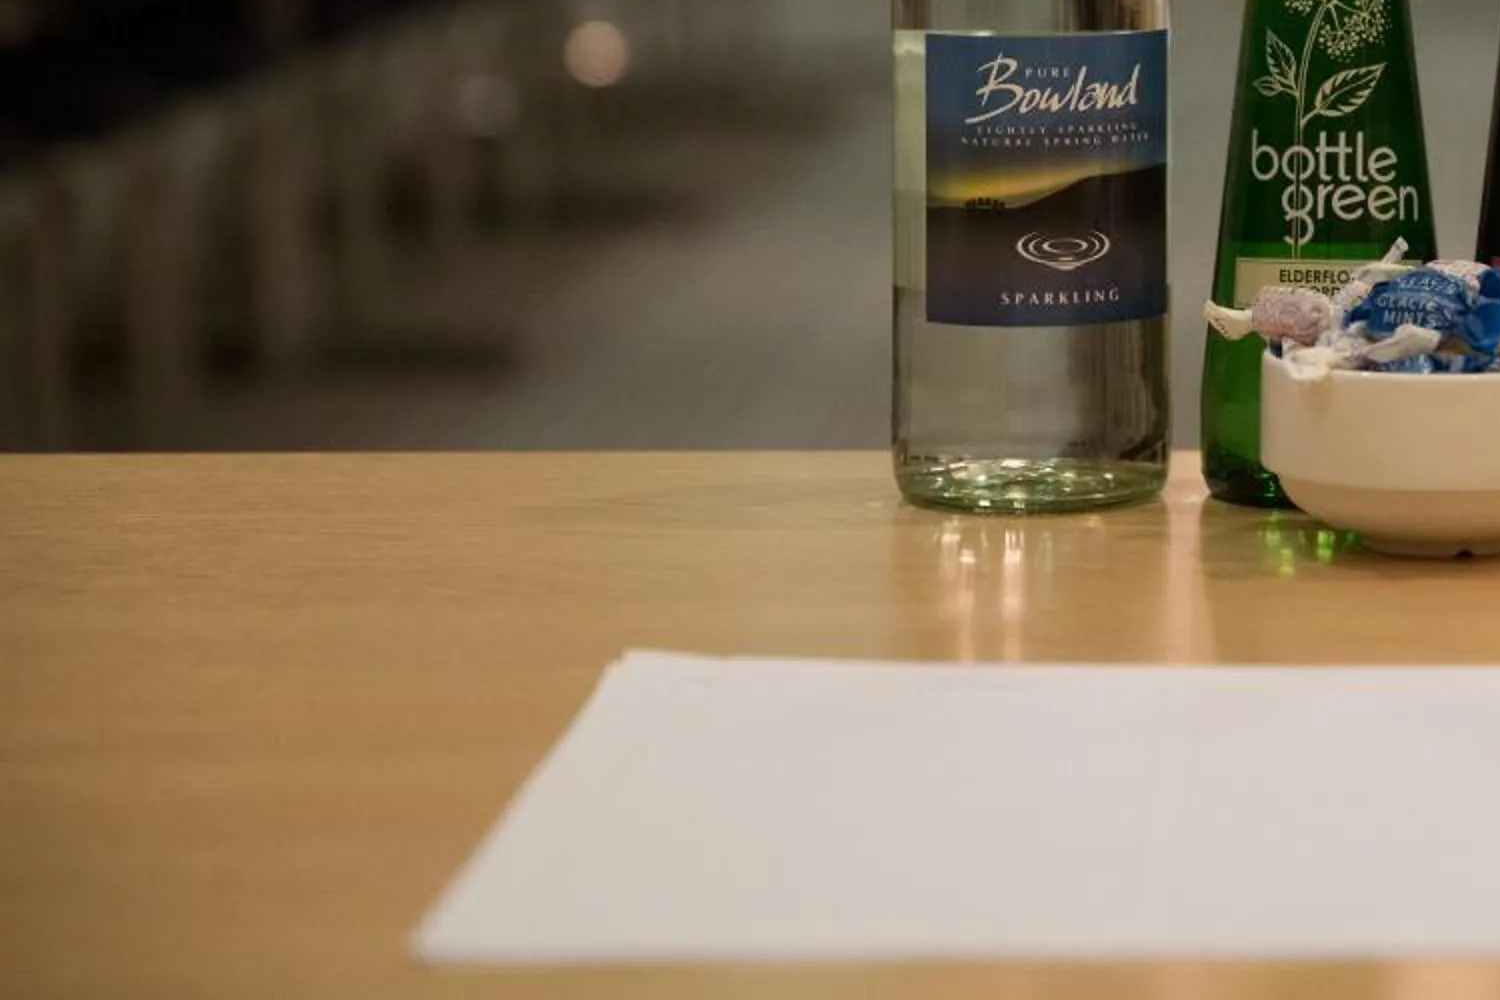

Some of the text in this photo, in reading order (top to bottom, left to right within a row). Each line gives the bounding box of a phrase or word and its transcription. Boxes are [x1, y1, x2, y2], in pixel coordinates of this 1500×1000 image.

[965, 51, 1141, 124] Bowland
[1025, 66, 1070, 79] PURE
[1251, 128, 1398, 183] bottle
[1281, 183, 1419, 246] green
[1279, 269, 1356, 284] ELDERFLO
[1000, 288, 1120, 305] SPARKLING
